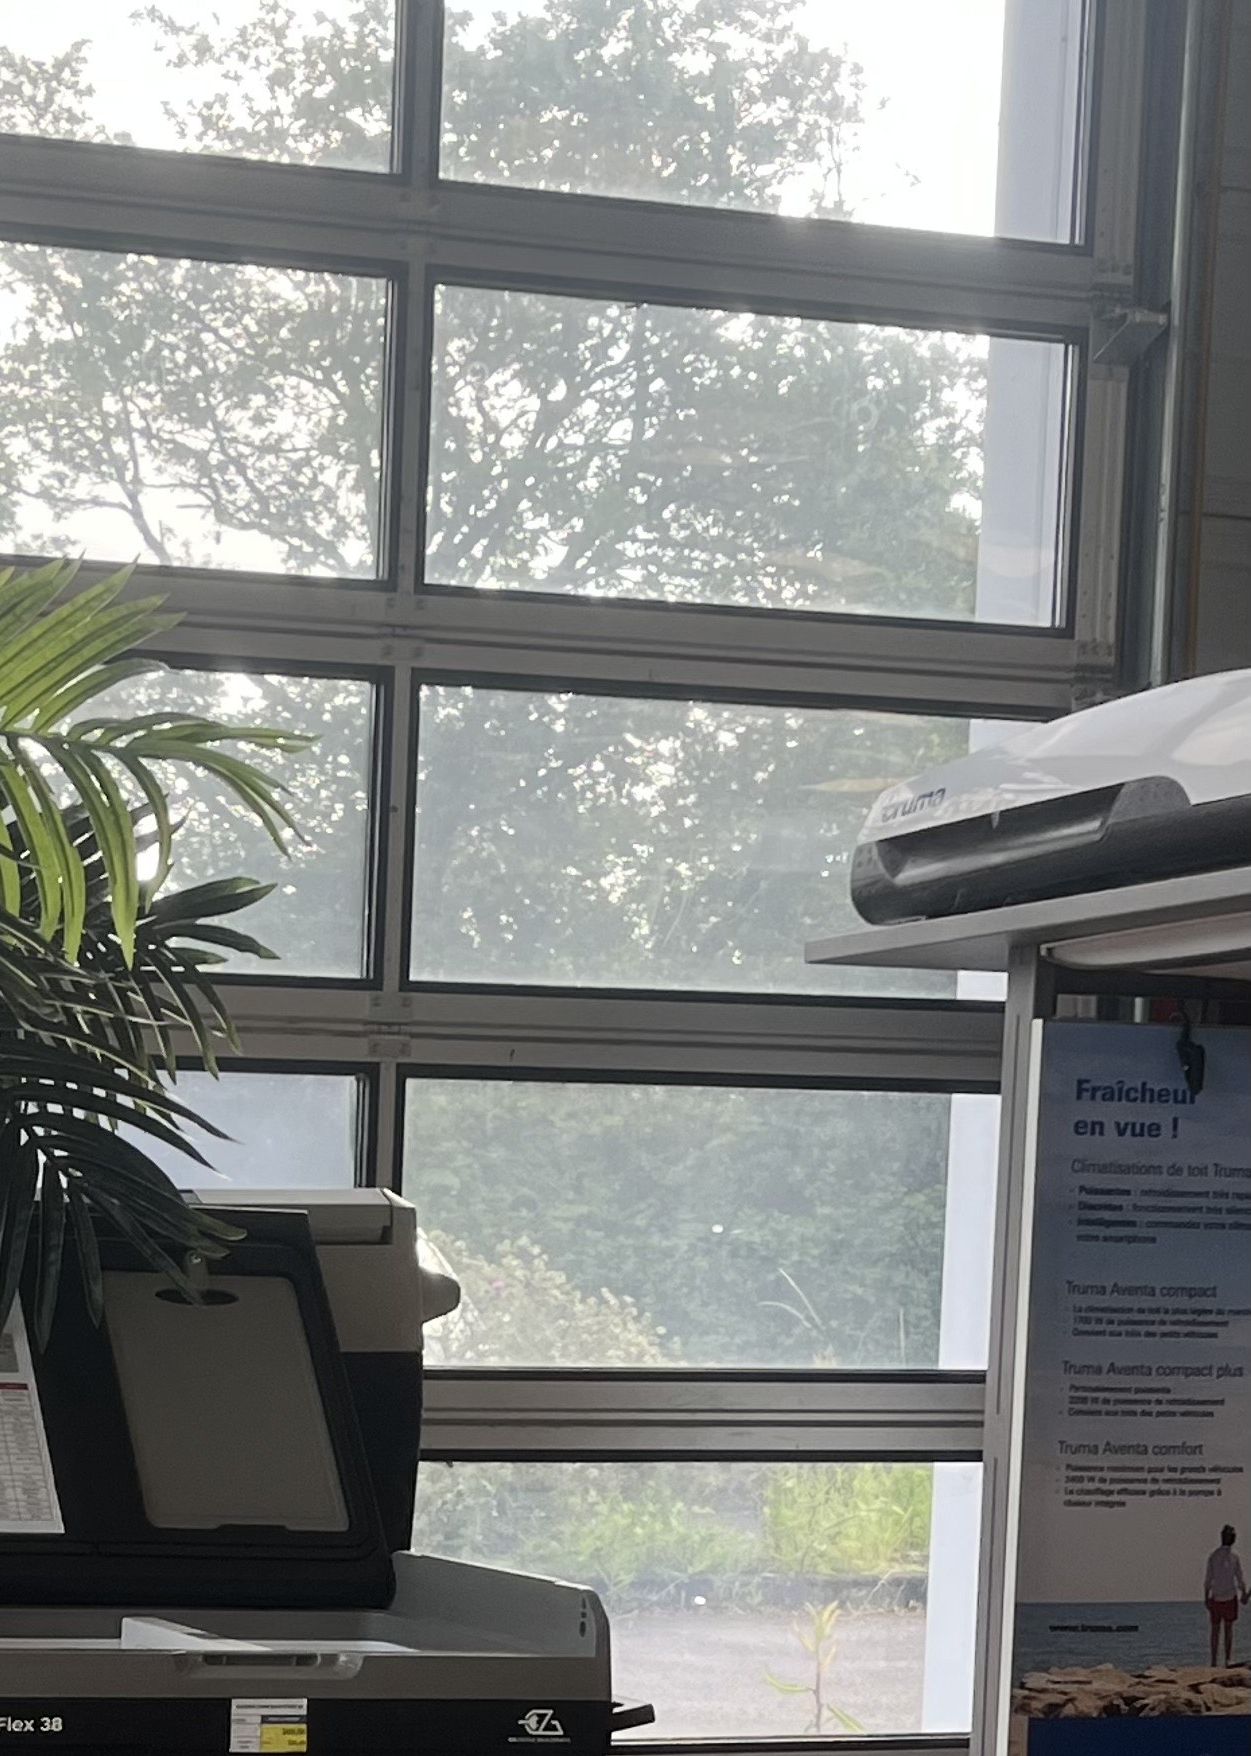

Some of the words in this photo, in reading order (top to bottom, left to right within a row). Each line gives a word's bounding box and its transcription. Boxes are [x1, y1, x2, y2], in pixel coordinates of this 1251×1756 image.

[1075, 1078, 1197, 1105] Fraîcheur
[1073, 1119, 1104, 1137] en
[1115, 1120, 1162, 1138] vue
[1171, 1117, 1179, 1138] !
[1071, 1158, 1163, 1176] Climatisations
[1166, 1163, 1183, 1177] de
[1187, 1163, 1208, 1178] toit
[1066, 1279, 1107, 1297] Truma
[1110, 1281, 1156, 1298] Aventa
[1160, 1284, 1217, 1299] compact
[1062, 1359, 1103, 1376] Truma
[1106, 1361, 1152, 1377] Aventa
[1156, 1363, 1213, 1380] compact
[1216, 1363, 1244, 1380] plus
[1057, 1439, 1099, 1456] Truma
[1102, 1440, 1148, 1456] Aventa
[1151, 1441, 1204, 1456] comfort
[40, 1716, 63, 1732] 38
